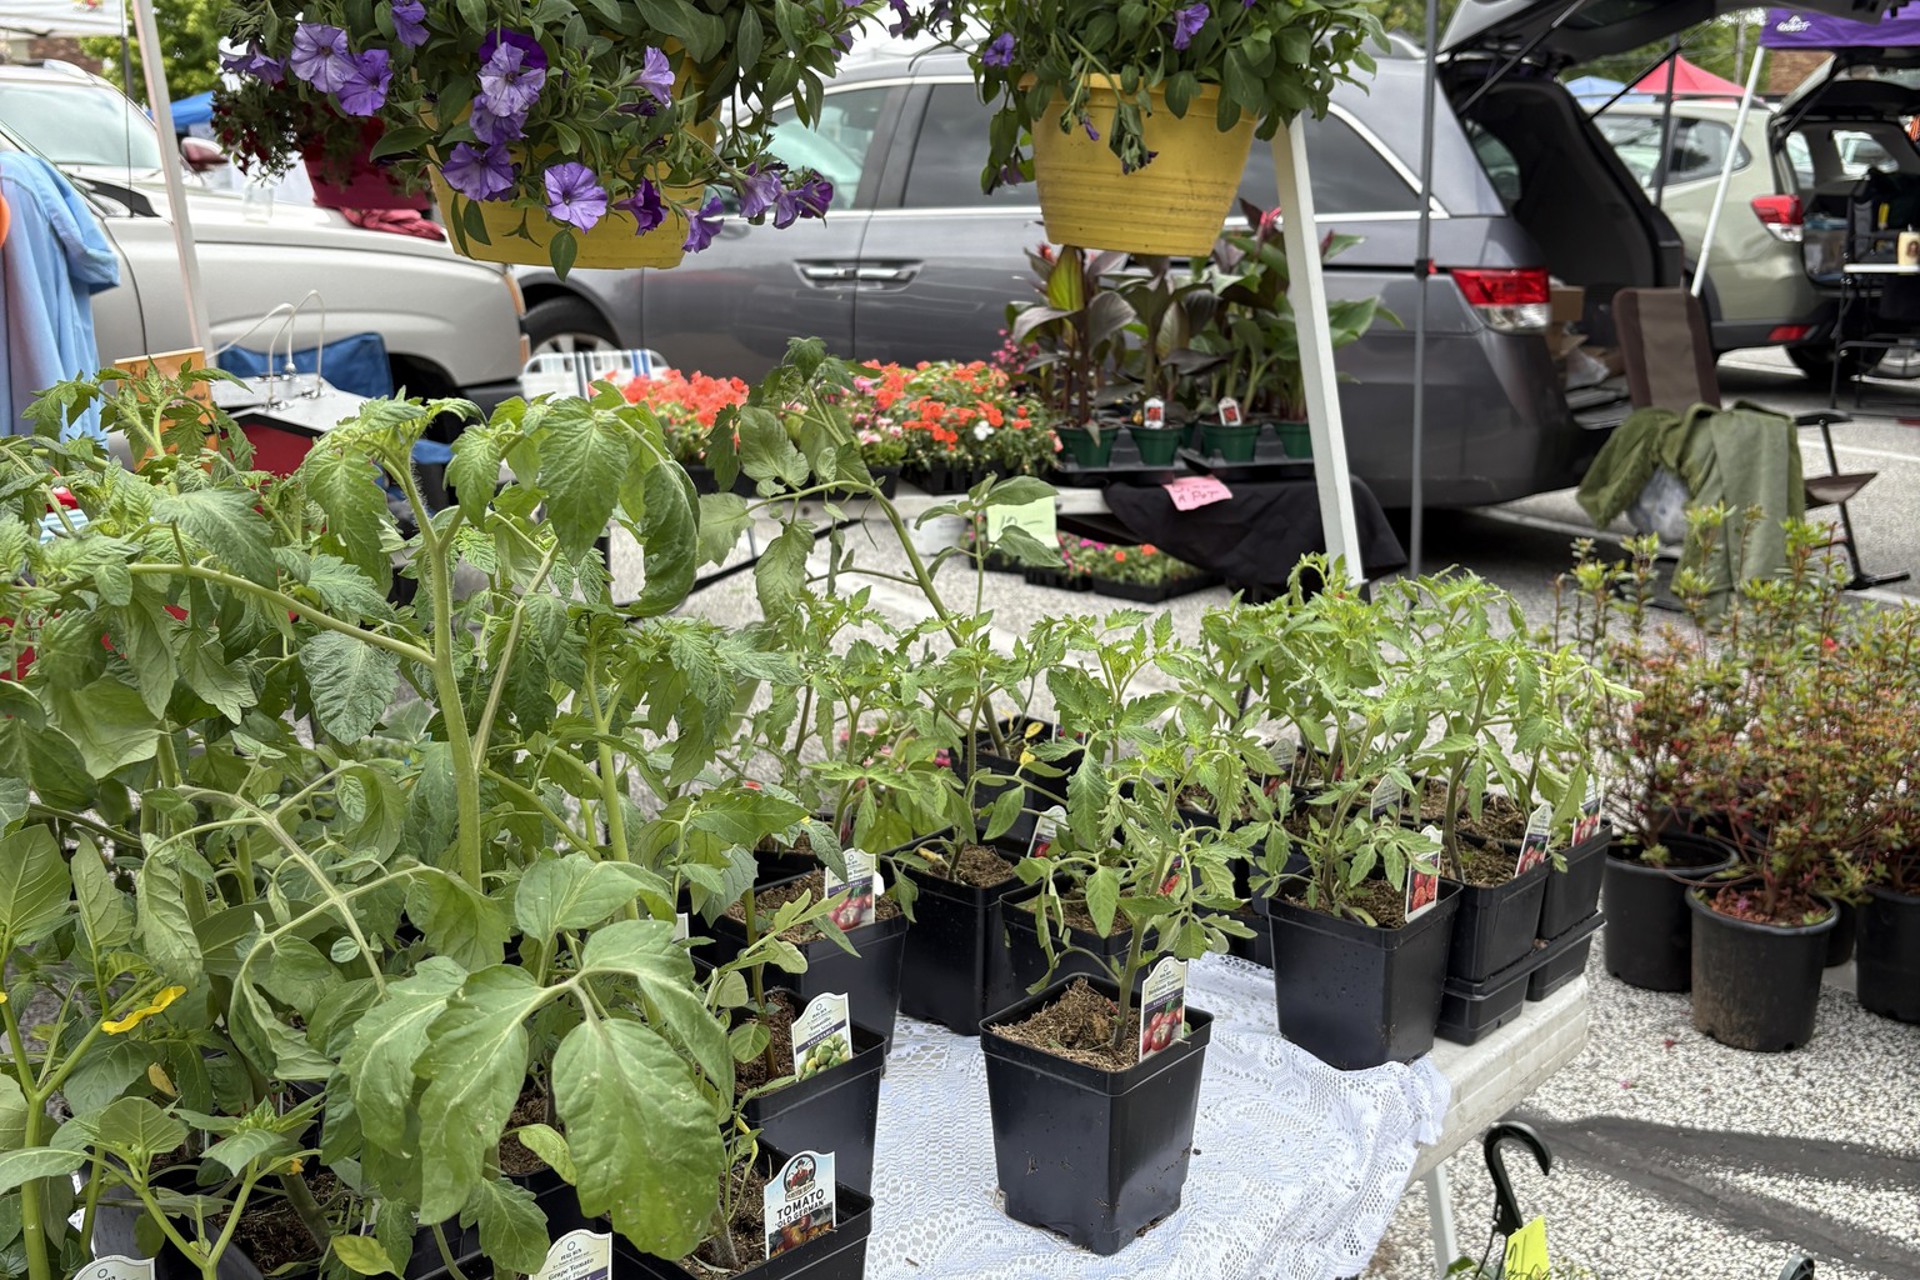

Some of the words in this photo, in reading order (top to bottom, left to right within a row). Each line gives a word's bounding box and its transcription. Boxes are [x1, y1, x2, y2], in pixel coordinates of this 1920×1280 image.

[807, 1027, 835, 1046] VEGETABLE
[777, 1188, 824, 1219] TOMATO
[570, 1258, 594, 1271] Tomato
